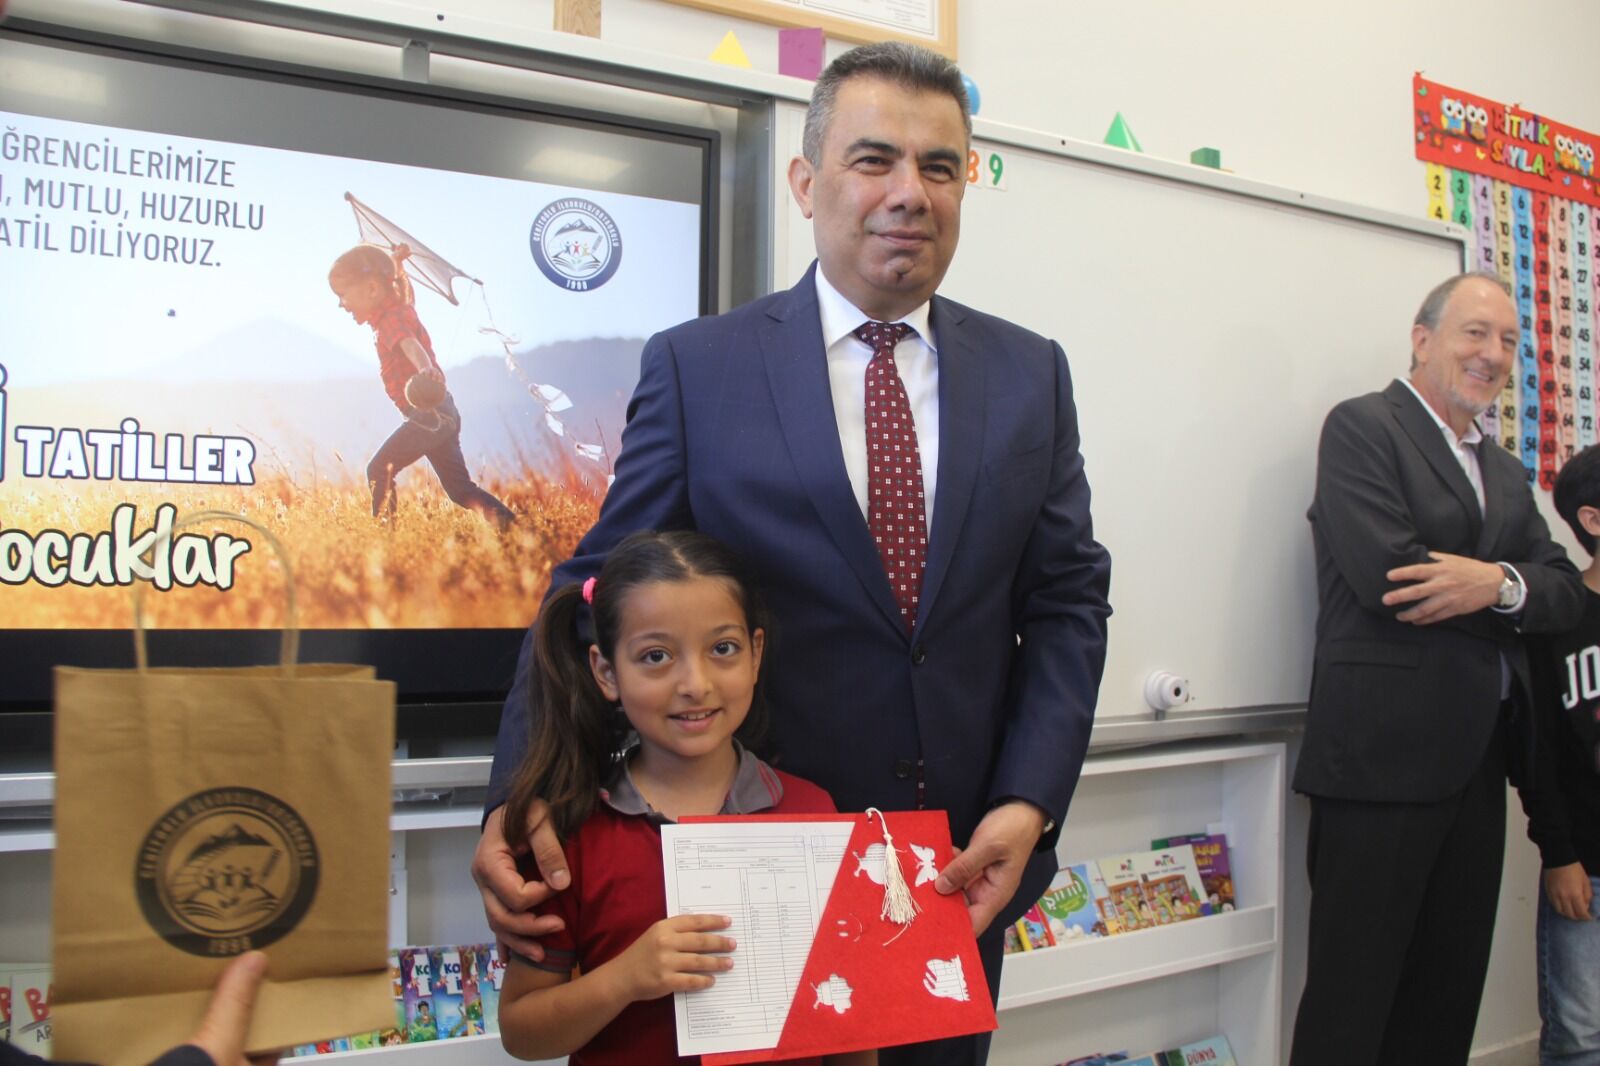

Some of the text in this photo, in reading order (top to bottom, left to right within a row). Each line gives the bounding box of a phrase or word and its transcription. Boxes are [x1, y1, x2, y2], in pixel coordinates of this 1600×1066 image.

[2, 126, 236, 188] ĞRENCİLERİMİZE
[989, 153, 1003, 186] 9
[1434, 174, 1441, 190] 2
[1457, 178, 1465, 194] 3
[24, 177, 129, 219] MUTLU,
[141, 191, 264, 231] HUZURLU
[1435, 206, 1443, 219] 4
[1460, 210, 1467, 225] 6
[70, 219, 221, 267] DİLİYORUZ.
[1579, 357, 1590, 371] 54
[1580, 386, 1591, 400] 63
[1581, 415, 1592, 430] 72
[15, 417, 256, 486] TATİLLER
[1562, 645, 1600, 710] JO
